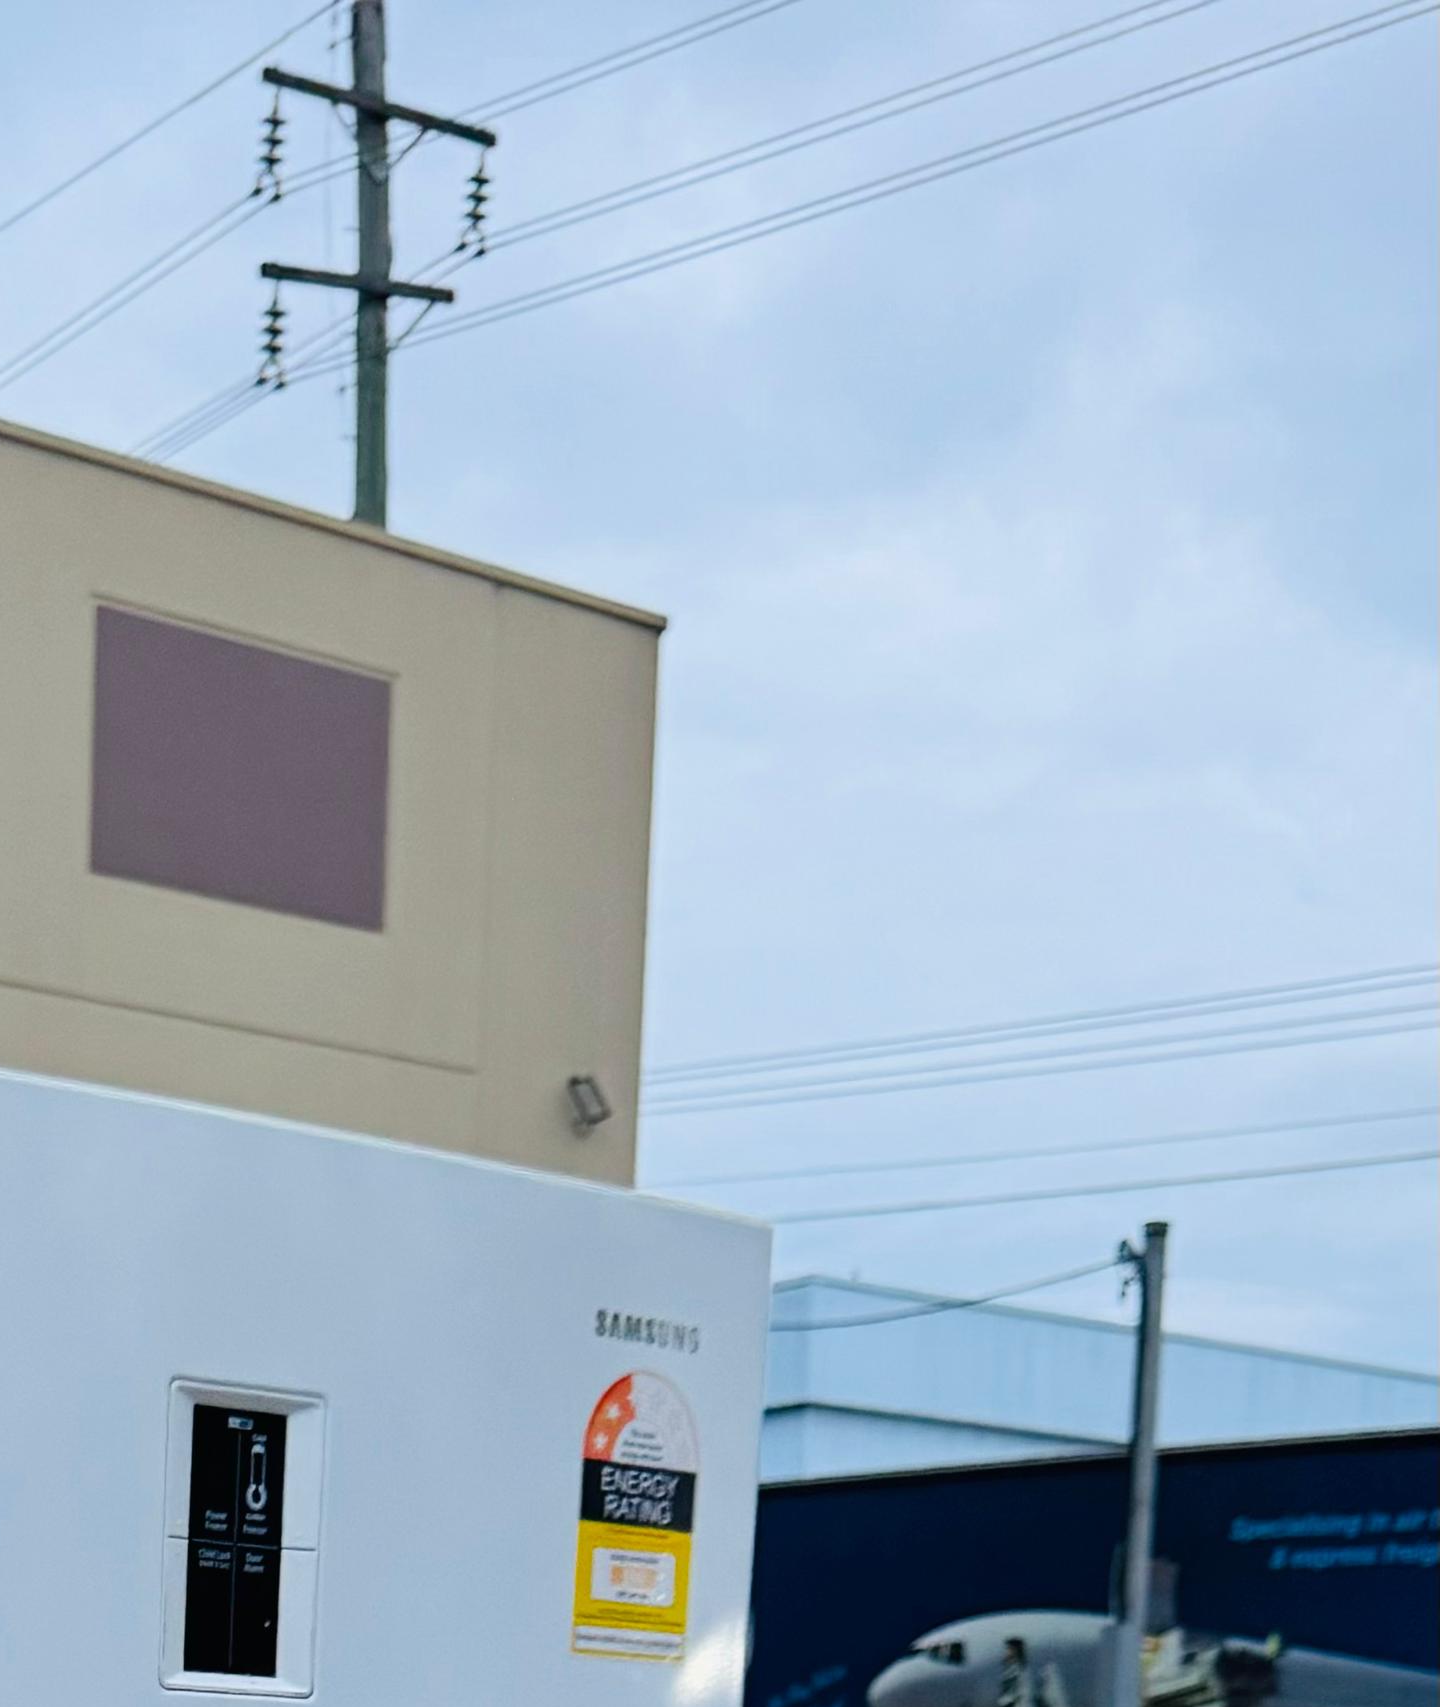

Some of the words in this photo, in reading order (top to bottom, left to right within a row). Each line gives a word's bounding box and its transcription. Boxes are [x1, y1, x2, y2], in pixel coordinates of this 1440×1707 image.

[594, 1308, 700, 1355] SAMSUNG
[601, 1465, 680, 1498] ENERGY
[602, 1493, 673, 1525] RATING
